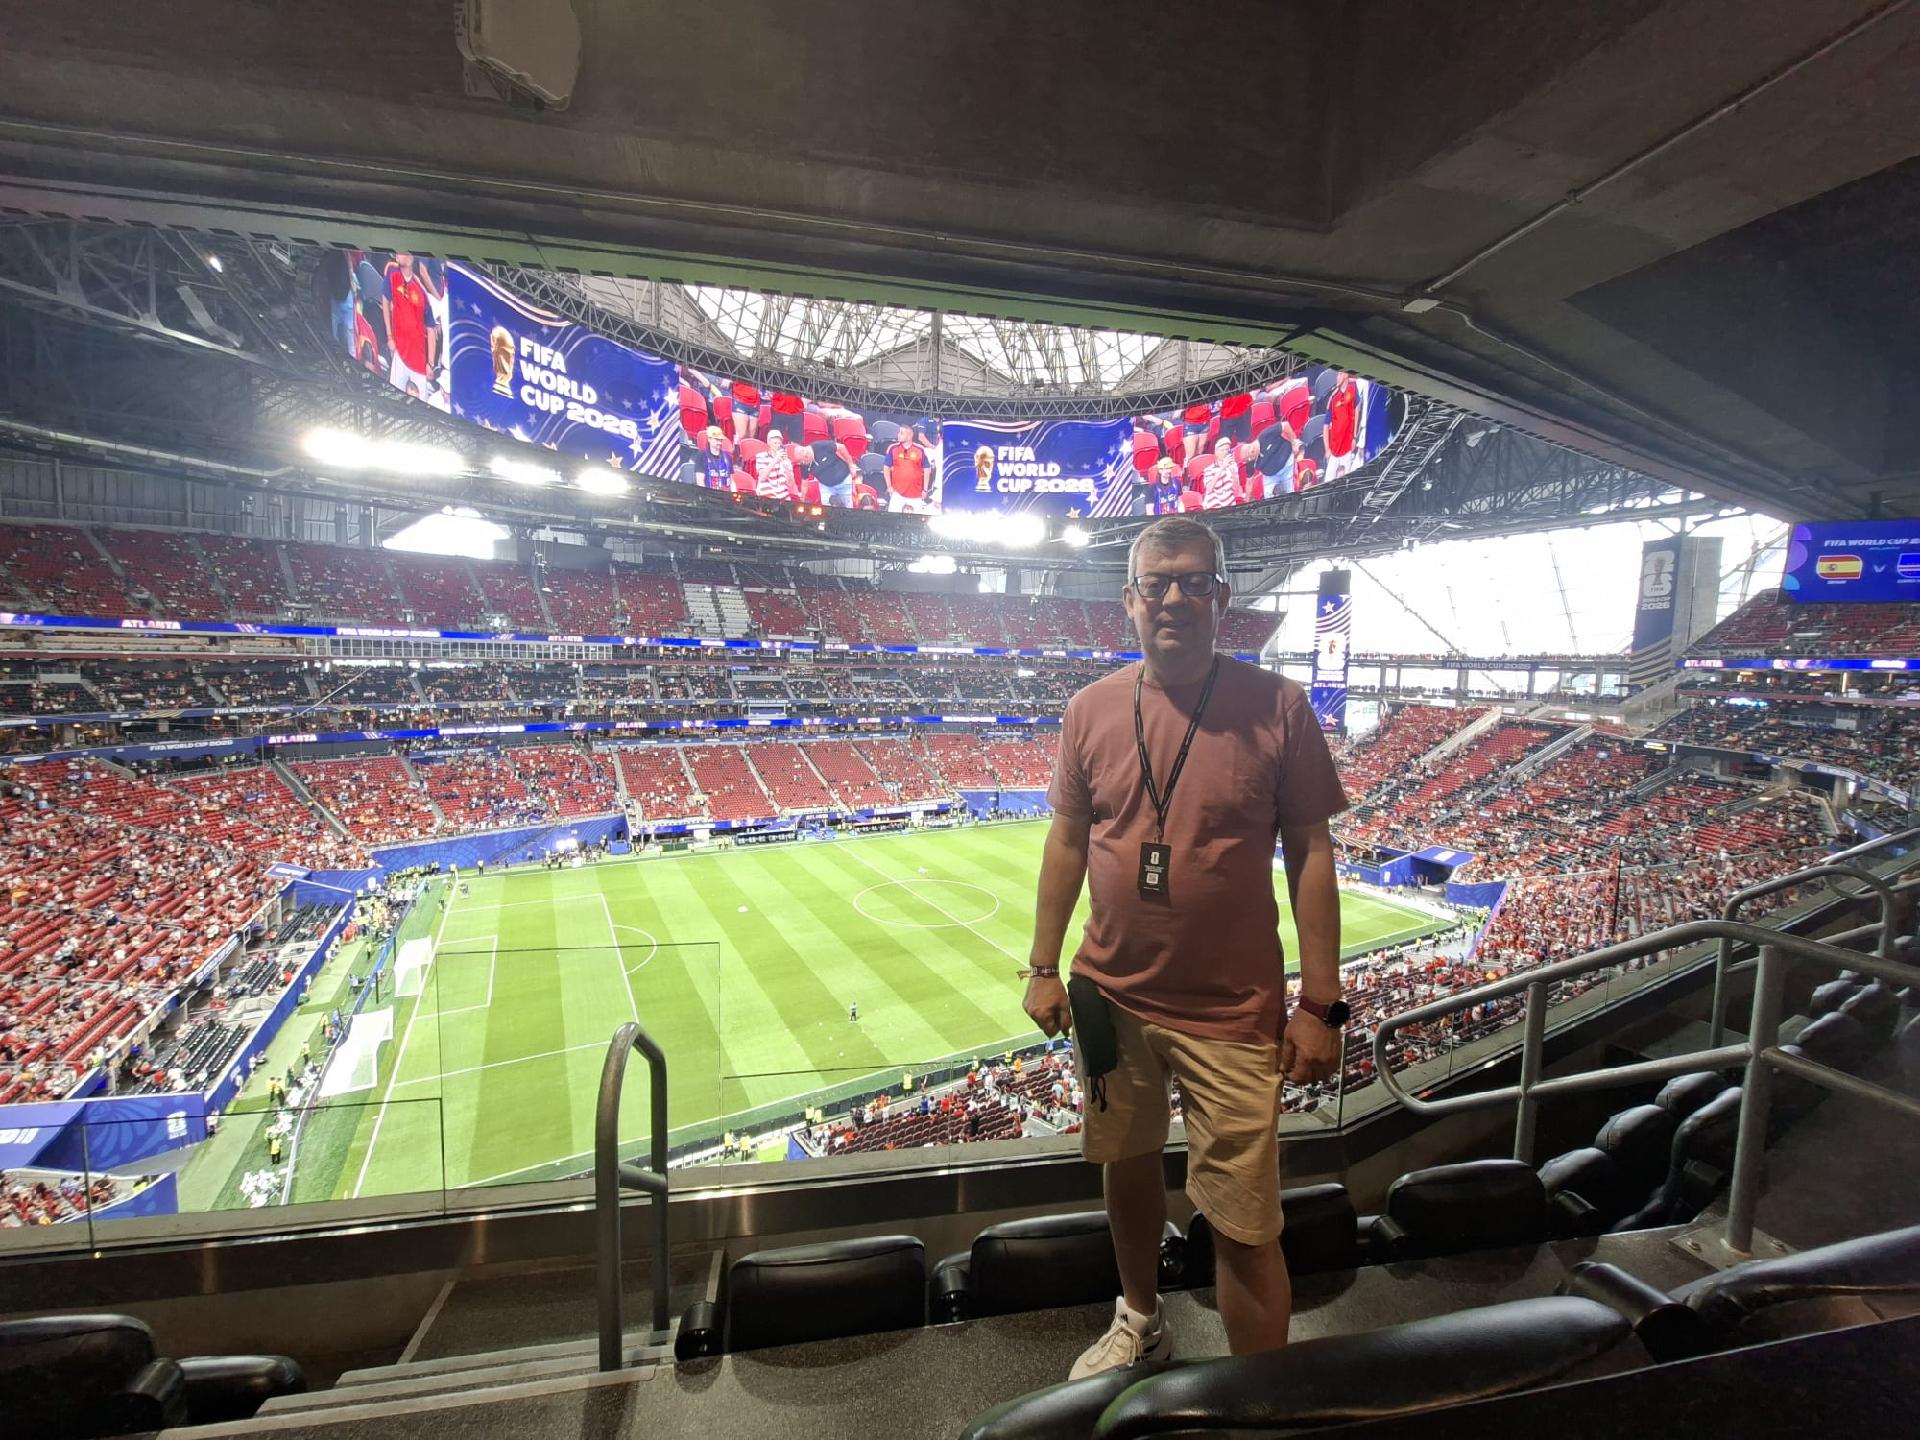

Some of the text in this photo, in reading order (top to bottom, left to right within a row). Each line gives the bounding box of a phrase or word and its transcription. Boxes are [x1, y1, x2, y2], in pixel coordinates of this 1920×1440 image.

[520, 336, 567, 374] FIFA
[520, 360, 598, 405] WORLD
[520, 385, 638, 440] CUP 2026
[998, 446, 1036, 462] FIFA
[997, 462, 1061, 477] WORLD
[997, 478, 1095, 493] CUP 2026
[1824, 540, 1848, 548] FIFA
[121, 619, 182, 630] ATLANTA
[357, 628, 392, 637] WORLD
[1683, 659, 1724, 668] ATLANTA
[268, 735, 318, 744] ATLANTA
